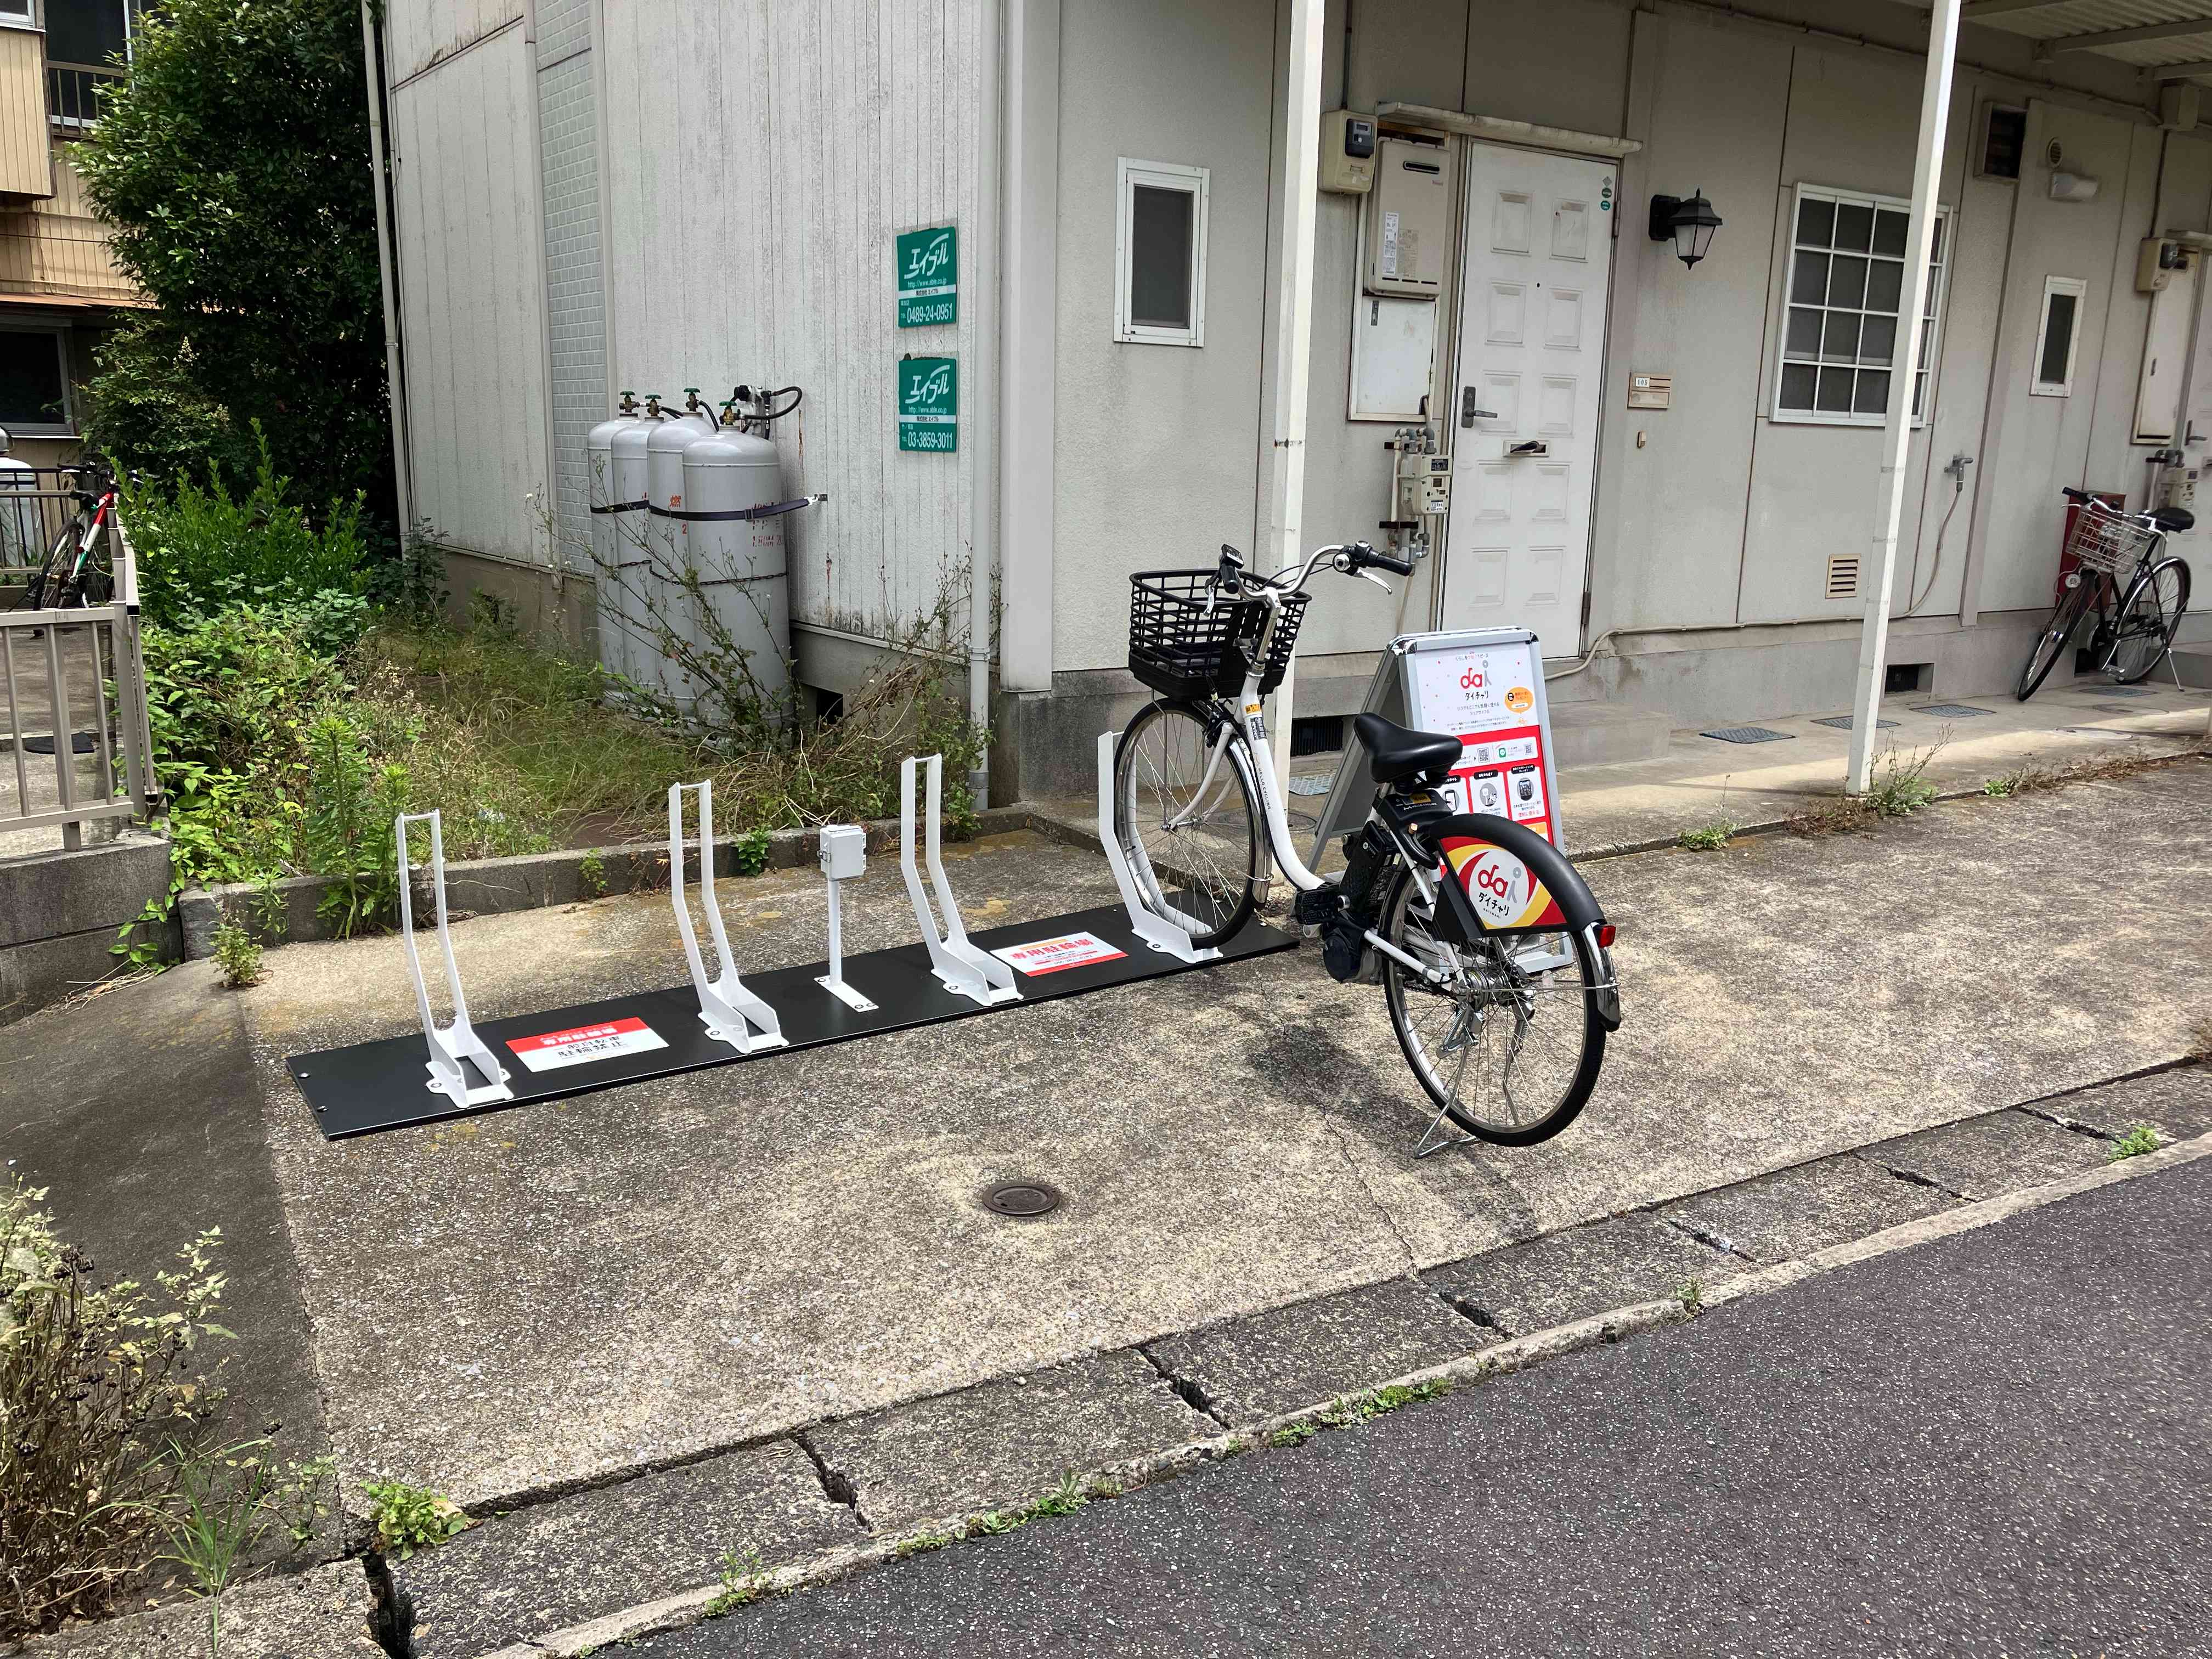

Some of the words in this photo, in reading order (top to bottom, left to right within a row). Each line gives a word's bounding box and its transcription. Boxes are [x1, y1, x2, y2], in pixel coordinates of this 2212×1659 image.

[904, 233, 949, 279] エイブル
[907, 303, 952, 323] 0489-24-0951
[905, 365, 950, 404] エイブル
[909, 406, 947, 415] http://www.able.co.jp
[908, 431, 952, 448] 03-3859-3011
[1465, 690, 1489, 701] ダイチャリ
[1262, 787, 1271, 810] CYCLING
[1478, 865, 1522, 904] dai
[1479, 892, 1509, 916] ダイチャリ
[1011, 939, 1093, 959] 専用駐輪場
[557, 1041, 628, 1057] 駐輪禁止
